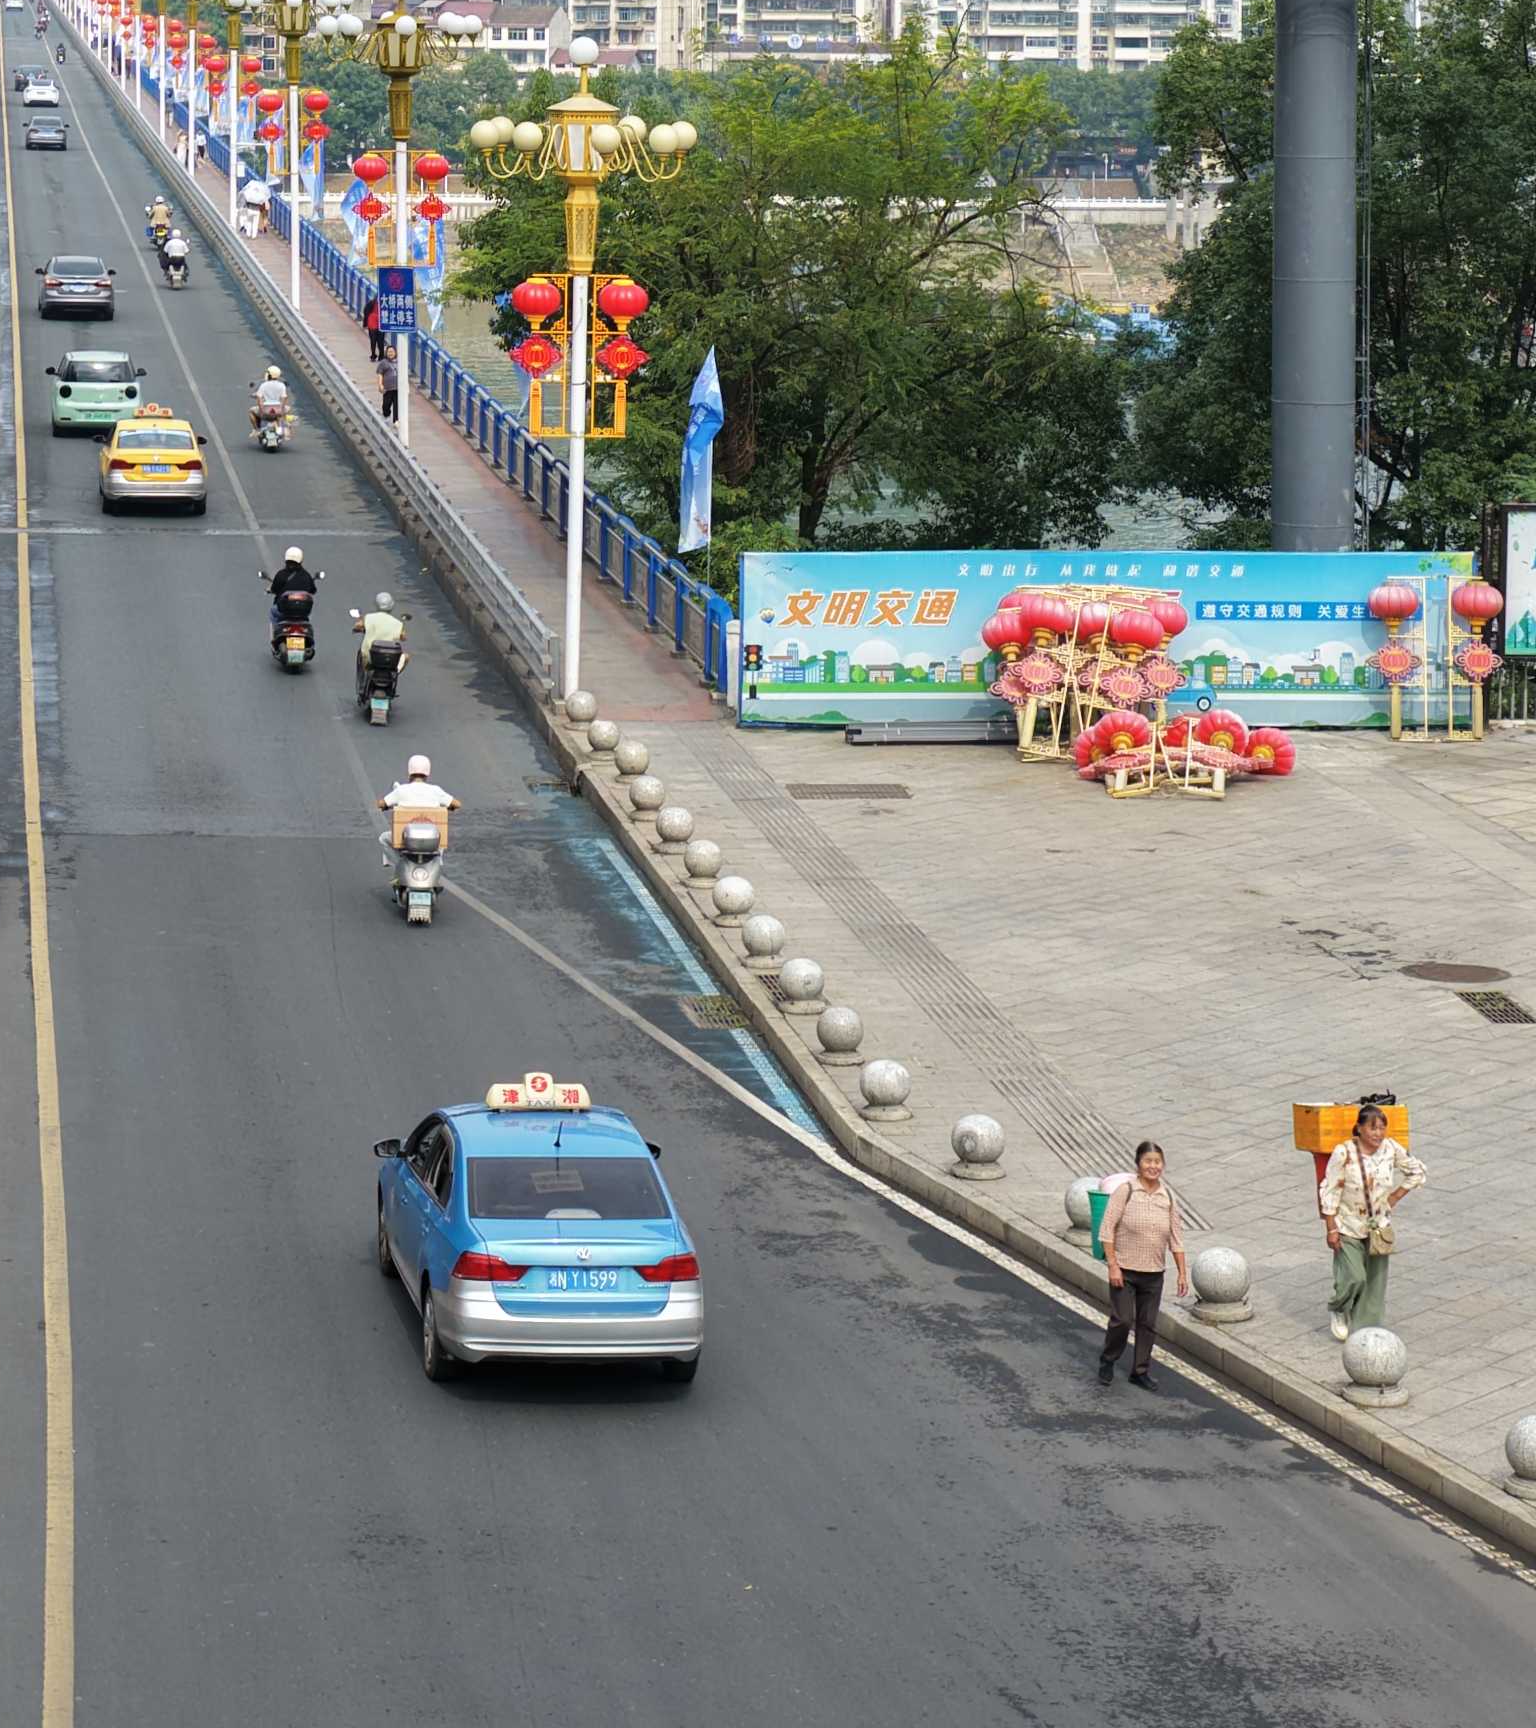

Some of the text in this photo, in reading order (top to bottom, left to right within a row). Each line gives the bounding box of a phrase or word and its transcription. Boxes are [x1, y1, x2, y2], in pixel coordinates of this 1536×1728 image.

[777, 588, 959, 627] 文明交通
[1202, 603, 1303, 618] 遵守交通规则
